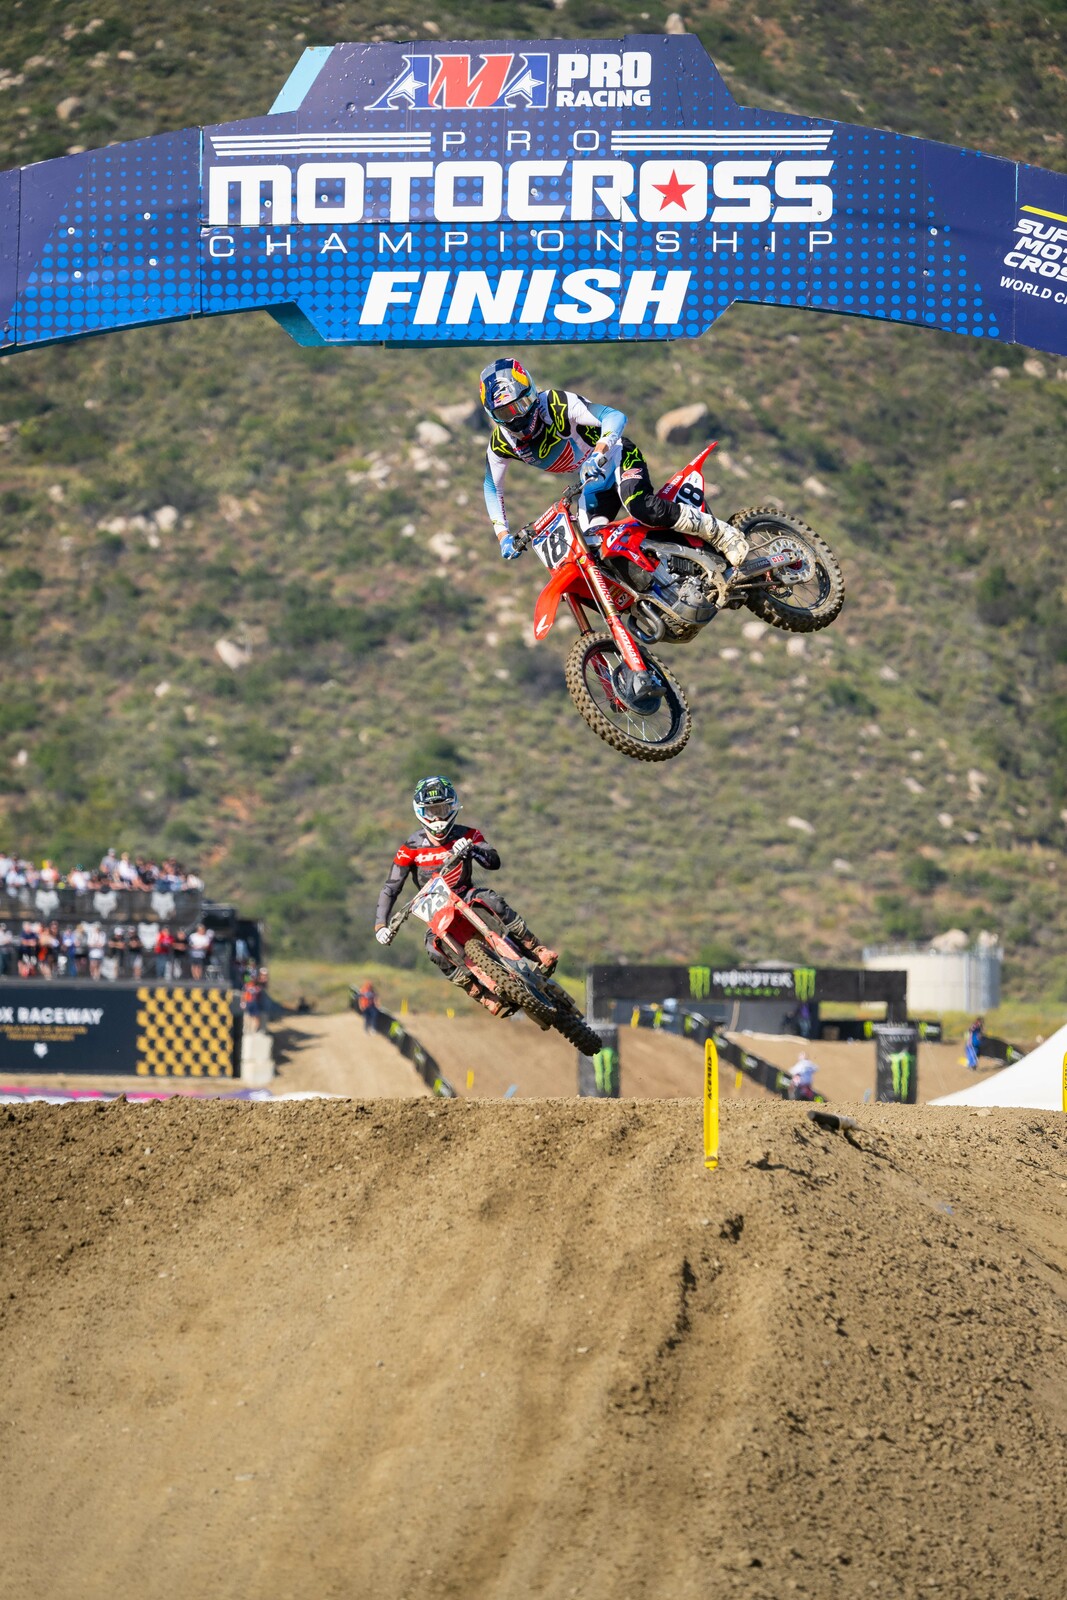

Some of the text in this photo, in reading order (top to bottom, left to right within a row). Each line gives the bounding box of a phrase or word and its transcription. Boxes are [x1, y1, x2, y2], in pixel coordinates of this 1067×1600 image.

[363, 51, 652, 111] AMA PRO
[556, 89, 652, 107] RACING
[442, 130, 600, 152] PRO
[208, 160, 835, 227] MOTOCROSS
[208, 229, 834, 258] CHAMPIONSHIP
[1014, 236, 1067, 264] MO
[359, 268, 691, 325] FINISH
[1000, 275, 1052, 299] WORLD
[662, 475, 683, 495] HONDA
[541, 525, 569, 569] 18
[619, 628, 641, 665] DUNLOP
[421, 885, 449, 921] 23
[0, 1006, 104, 1025] X RACEWAY
